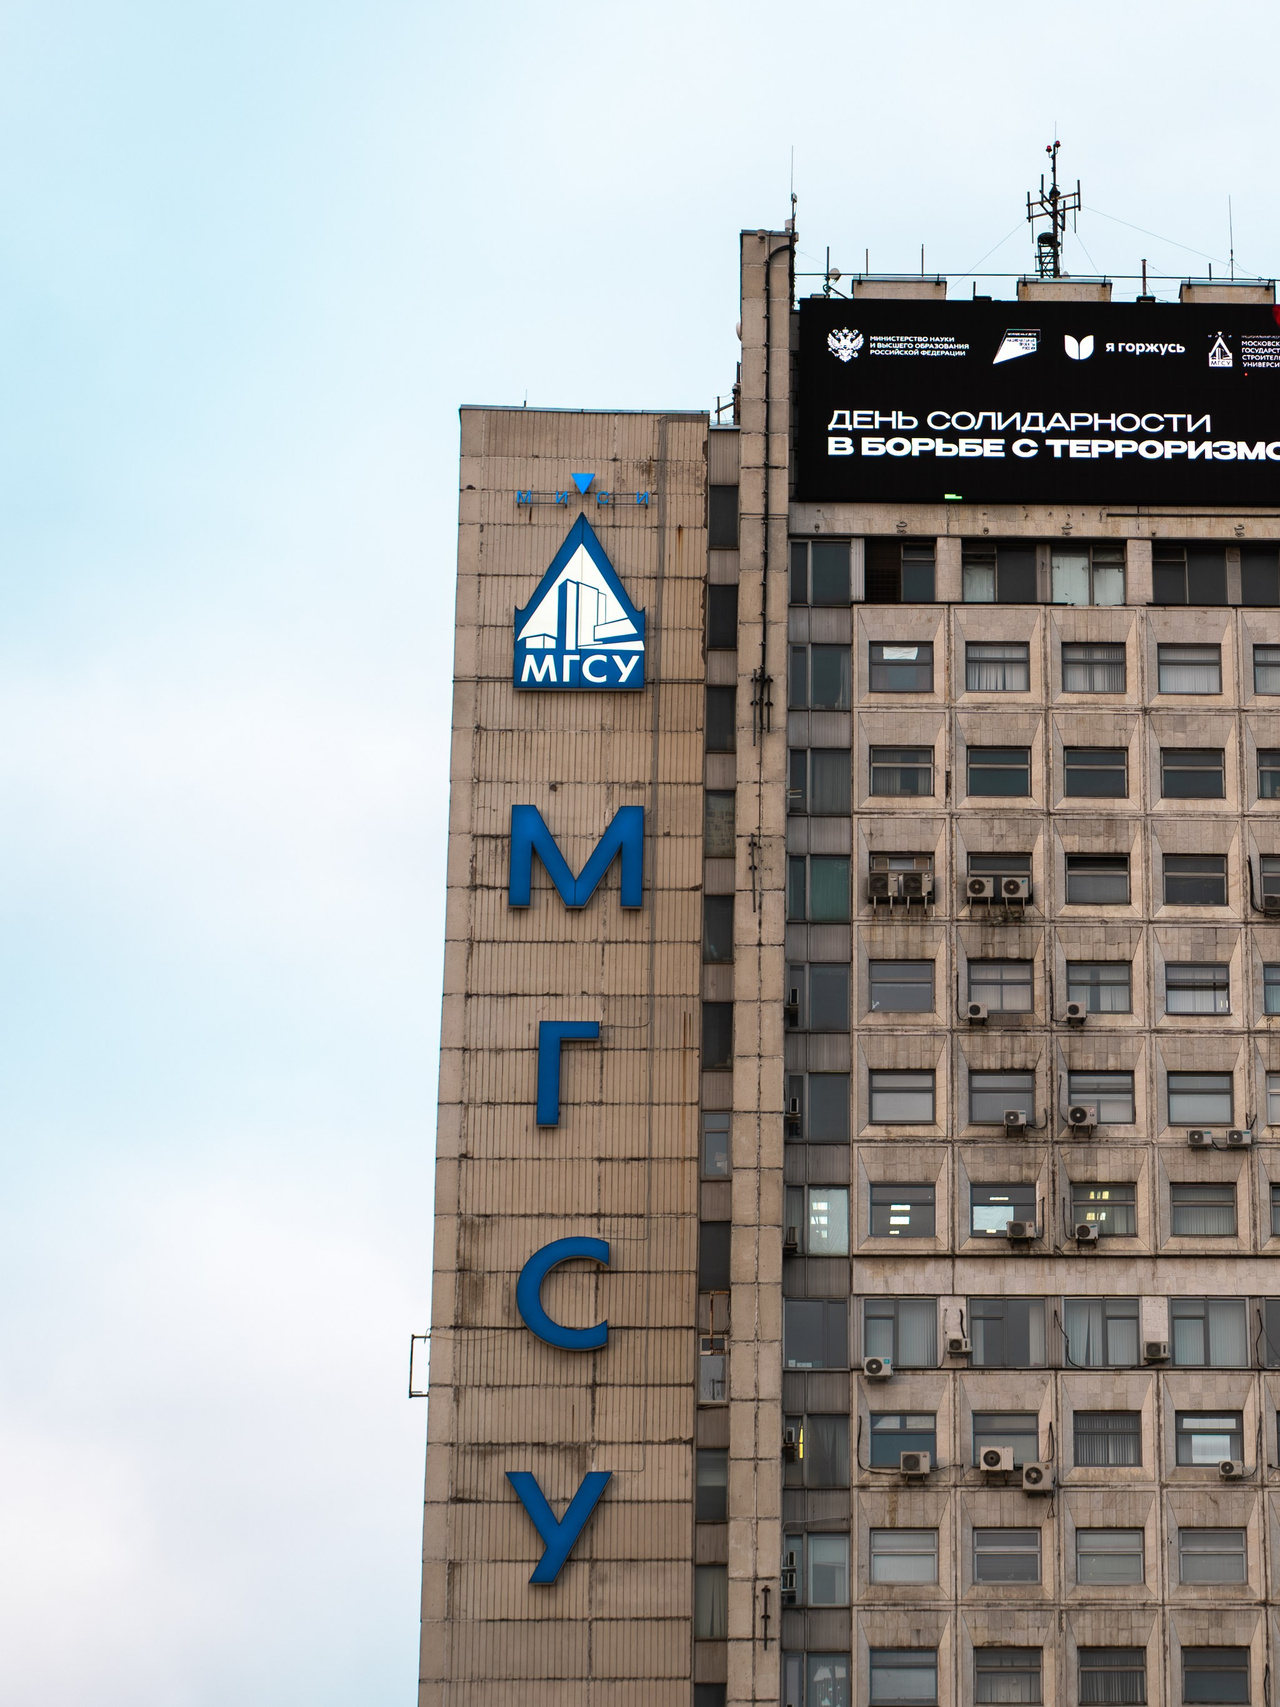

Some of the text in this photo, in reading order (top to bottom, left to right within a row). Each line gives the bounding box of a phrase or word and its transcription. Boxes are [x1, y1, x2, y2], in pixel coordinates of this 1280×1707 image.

[1105, 342, 1186, 356] я горжусь
[828, 410, 1211, 433] ДЕНЬ СОЛИДАРНОСТИ
[827, 436, 854, 456] В
[861, 436, 1006, 458] БОРЬБЕ
[1011, 438, 1039, 458] С
[520, 654, 640, 683] МГСУ
